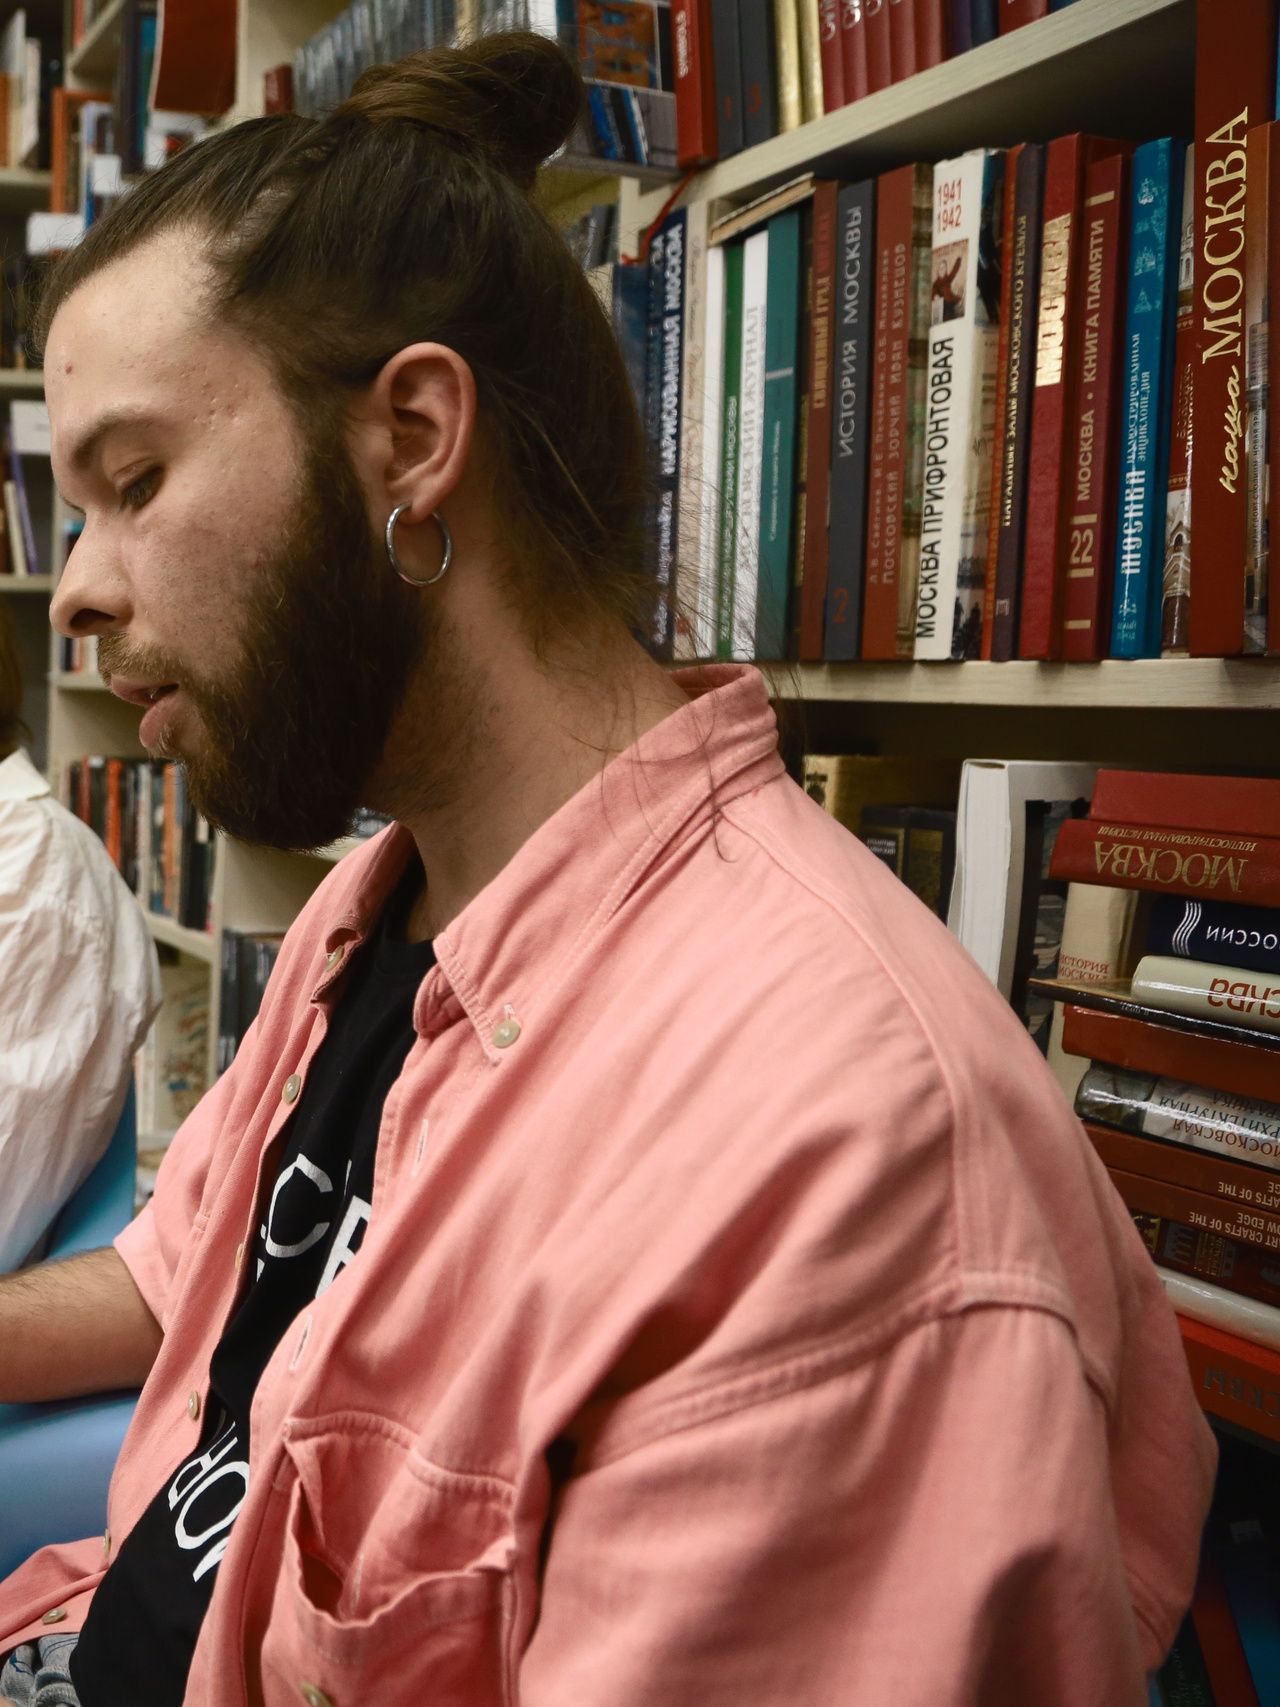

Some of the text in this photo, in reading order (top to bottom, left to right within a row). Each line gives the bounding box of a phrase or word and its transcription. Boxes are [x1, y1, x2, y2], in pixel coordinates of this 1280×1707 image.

[675, 10, 689, 78] SYMBOLS
[937, 177, 962, 207] 1941
[937, 204, 962, 234] 1942
[664, 223, 683, 311] МОСКВА
[1013, 215, 1027, 277] КРЕМЛЯ
[892, 242, 906, 330] КУЗНЕЦОВ
[1035, 213, 1071, 387] МОСКВА
[1202, 105, 1248, 493] наша МОСКВА
[742, 305, 758, 403] ЖУРНАЛ
[839, 205, 862, 458] ИСТОРИЯ МОСКВЫ
[890, 340, 902, 384] ИВАН
[1009, 279, 1024, 394] МОСКОВСКОГО
[1077, 219, 1104, 501] МОСКВА КНИГА ПАМЯТИ
[725, 395, 738, 459] МОСКВЫ
[1006, 397, 1017, 439] ЗАЛЫ
[1137, 371, 1152, 462] ЭНЦИКЛОПЕДИЯ
[1252, 429, 1261, 456] НОВАЯ
[915, 337, 954, 639] МОСКВА ПРИФРОНТОВАЯ
[1002, 443, 1015, 527] ПАРАДНЫЕ
[882, 470, 899, 584] МОСКОВСКИЙ
[1070, 528, 1094, 564] 22
[1120, 470, 1146, 575] МОСКВА
[832, 587, 849, 623] 2
[1093, 841, 1248, 893] МОСКВА
[1096, 826, 1257, 852] ИЛЛЮСТРИРОВАННАЯ ИСТОРИЯ
[1205, 924, 1280, 951] ОССИИ
[1217, 1181, 1253, 1201] OF THE
[1236, 1212, 1265, 1230] EDGE
[1188, 1211, 1263, 1244] CRAFTS OF THE
